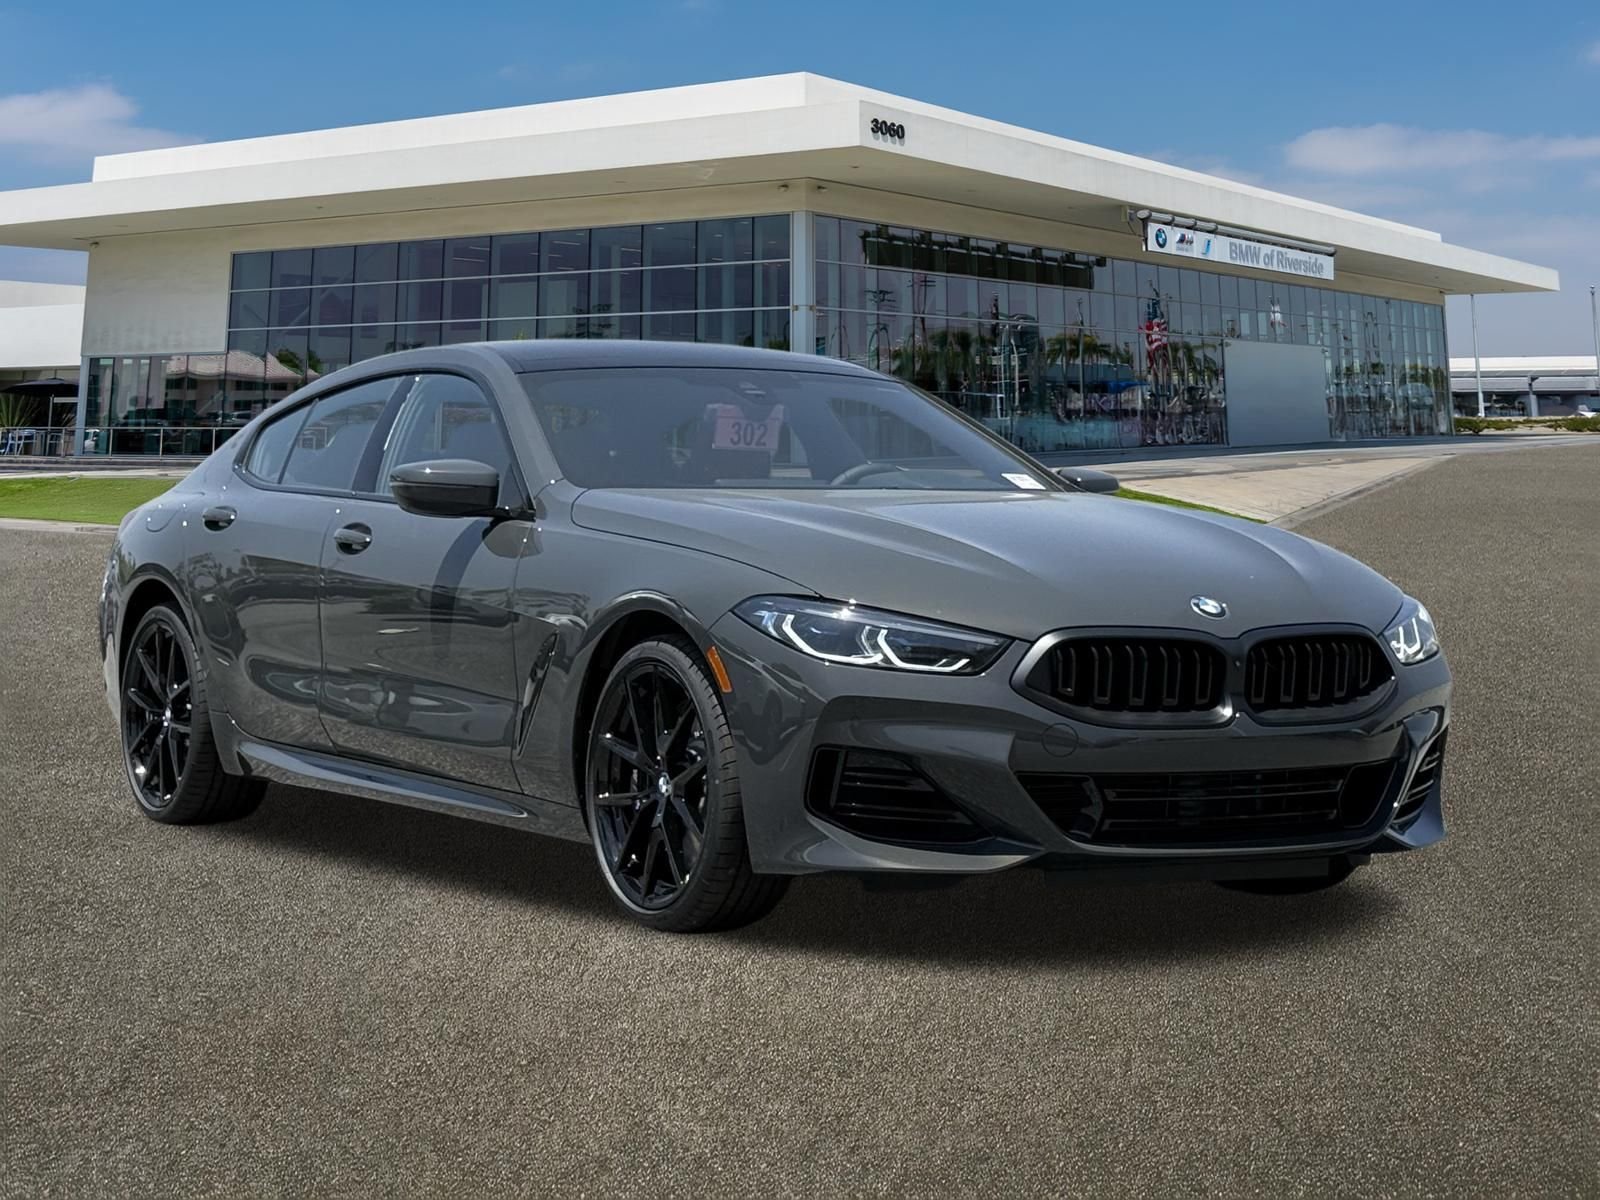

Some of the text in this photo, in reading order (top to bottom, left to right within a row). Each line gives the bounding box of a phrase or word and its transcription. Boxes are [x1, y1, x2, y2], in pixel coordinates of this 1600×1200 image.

[870, 118, 905, 139] 3060
[1229, 241, 1261, 265] BMW
[1263, 249, 1275, 267] of
[1276, 250, 1324, 275] Riverside
[729, 421, 768, 447] 302
